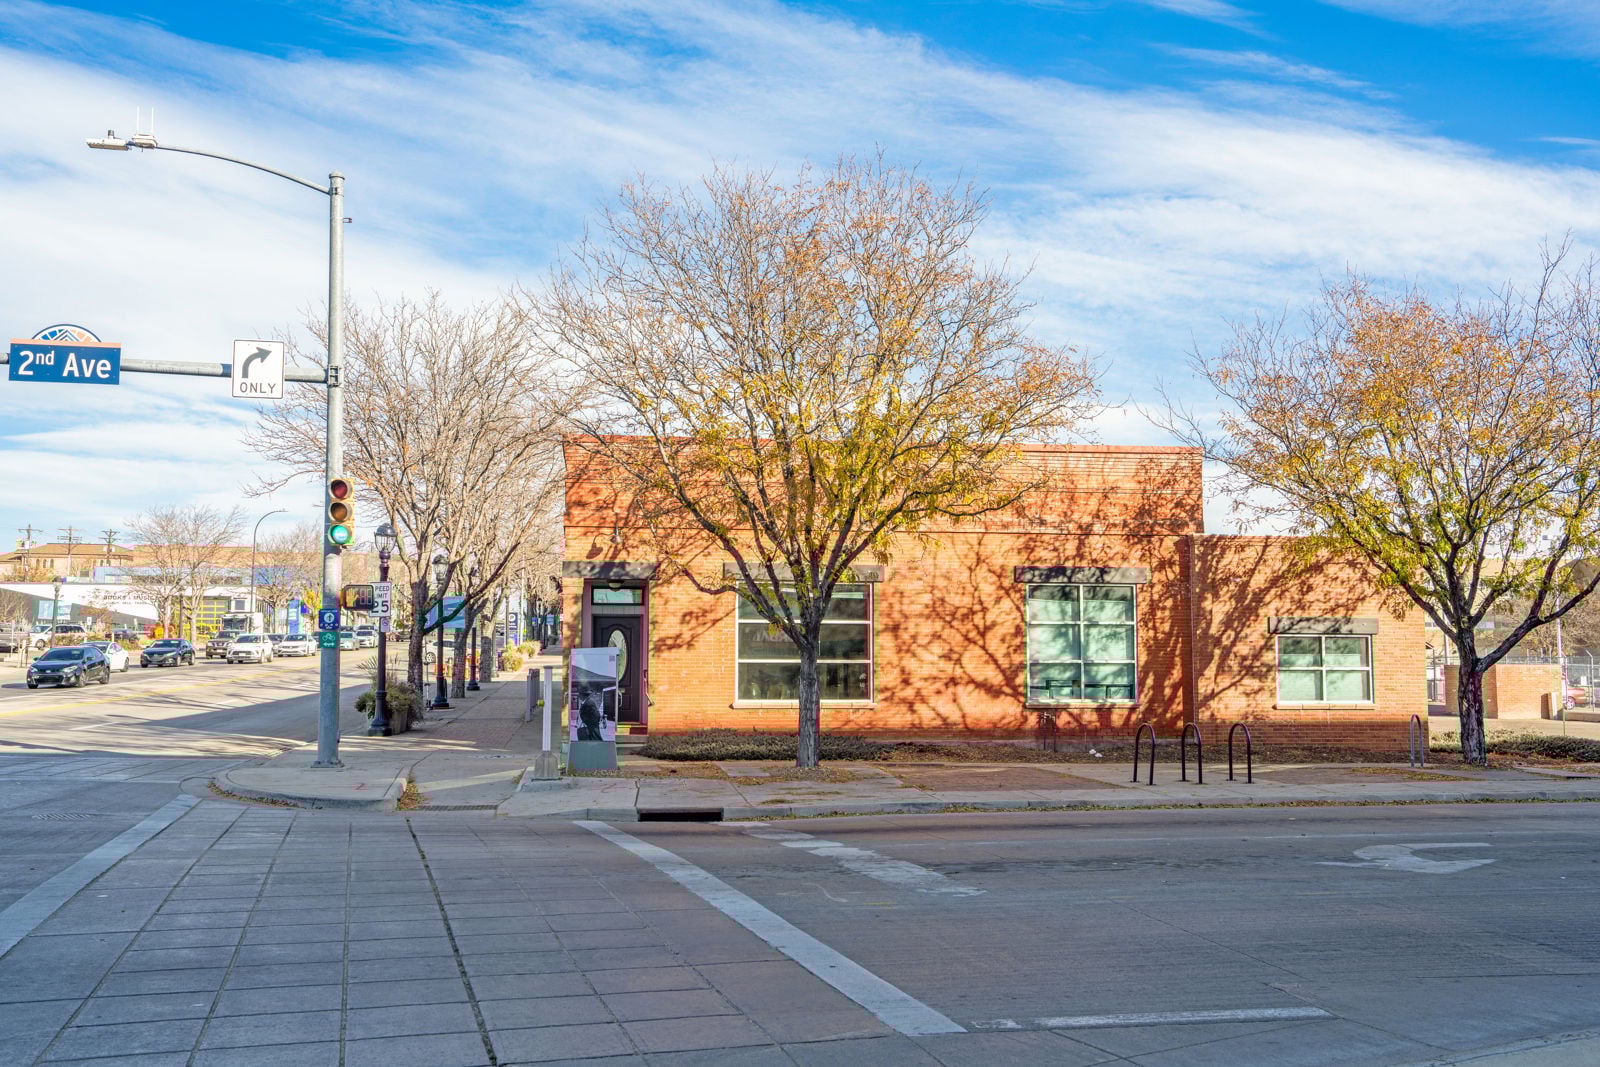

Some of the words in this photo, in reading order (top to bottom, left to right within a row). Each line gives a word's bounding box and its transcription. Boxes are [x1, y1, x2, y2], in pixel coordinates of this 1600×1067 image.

[18, 350, 55, 376] 2nd
[62, 352, 112, 379] Ave
[240, 382, 276, 394] ONLY
[371, 600, 389, 613] 25
